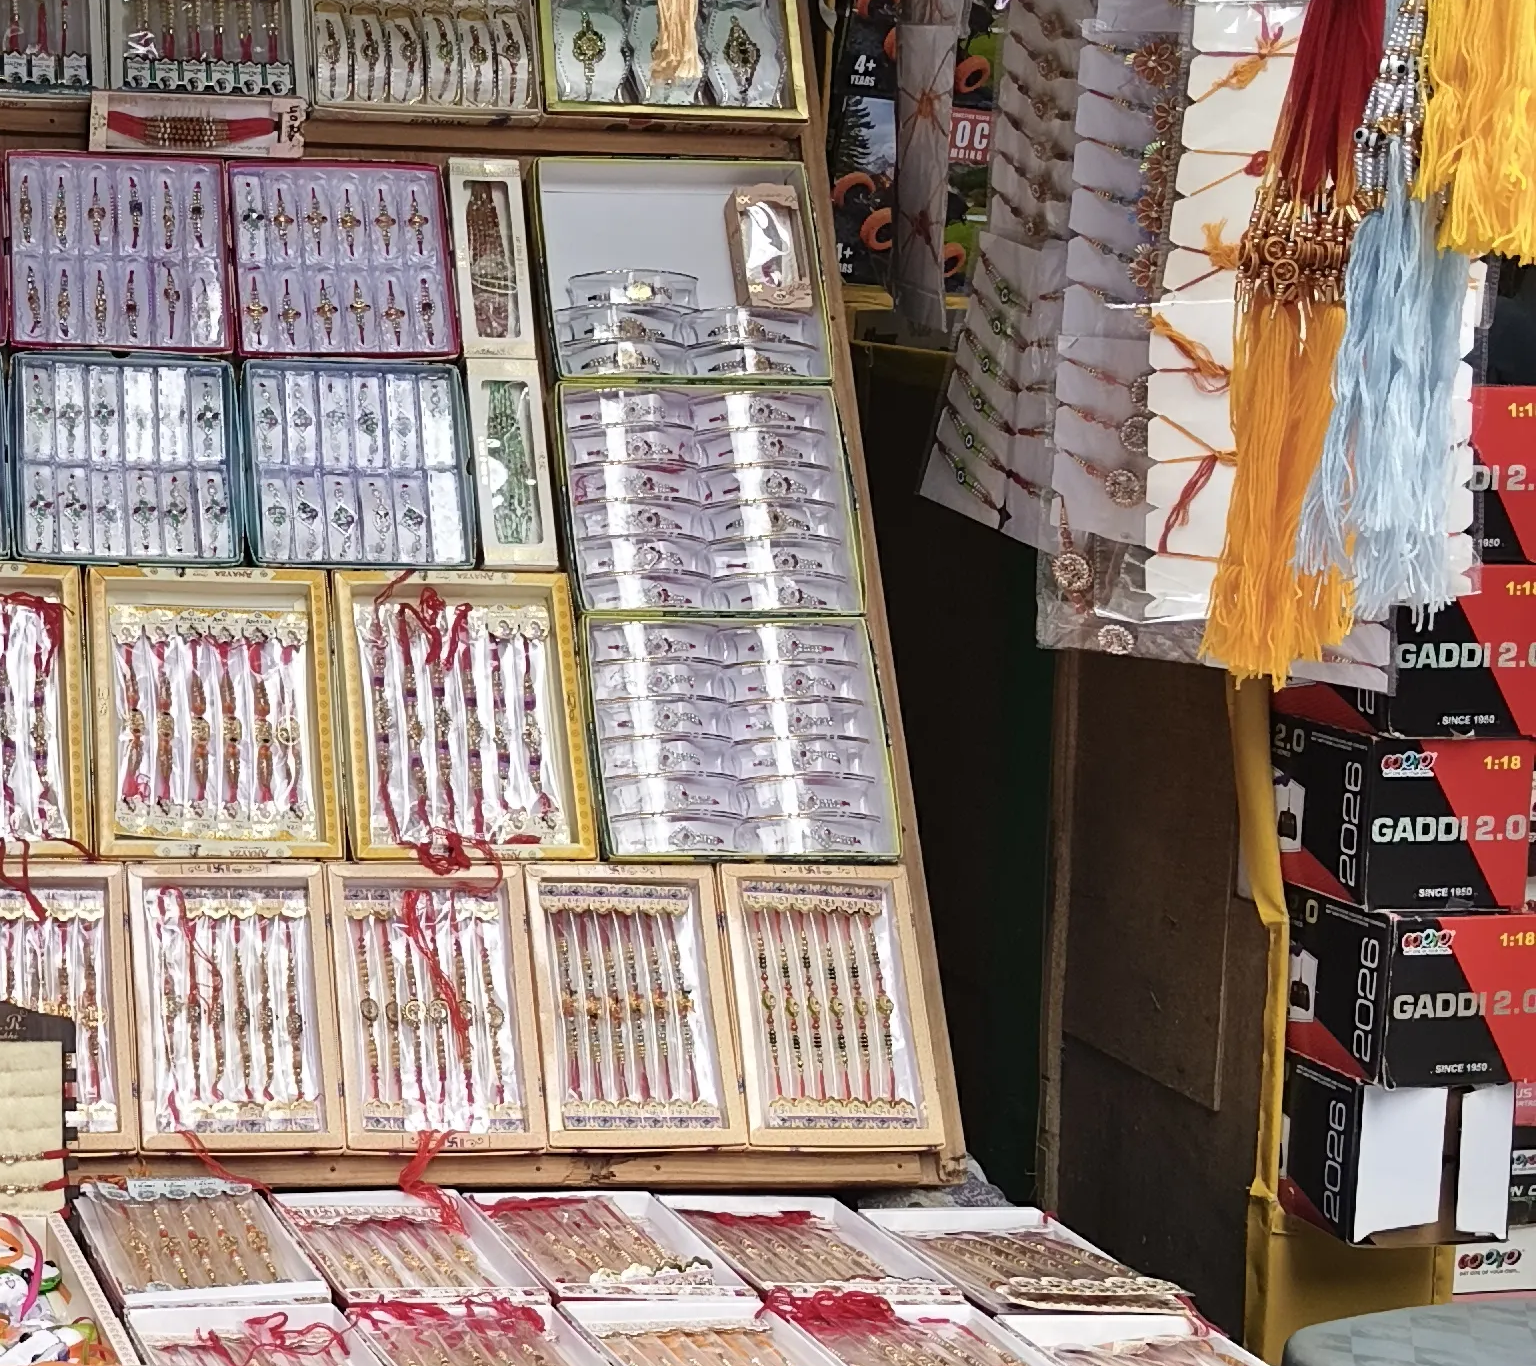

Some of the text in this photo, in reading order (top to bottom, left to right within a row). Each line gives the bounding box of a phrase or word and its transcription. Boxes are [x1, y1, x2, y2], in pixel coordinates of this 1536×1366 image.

[853, 54, 877, 74] 4+
[849, 74, 876, 87] YEARS
[1508, 402, 1536, 418] 1:1
[1507, 464, 1536, 491] 2.
[1396, 641, 1492, 670] GADDI
[1442, 715, 1496, 725] SINCE 1950
[1273, 722, 1305, 753] 2.0
[1483, 755, 1521, 770] 1:18
[1338, 761, 1363, 887] 2026
[1371, 814, 1527, 843] GADDI 2.0
[1418, 887, 1473, 898] SINCE 1950
[1499, 931, 1536, 947] 1:18
[1352, 937, 1380, 1063] 2026
[1392, 988, 1536, 1021] GADDI 2.0
[1435, 1062, 1488, 1075] SINCE 1950
[1323, 1101, 1347, 1223] 2026
